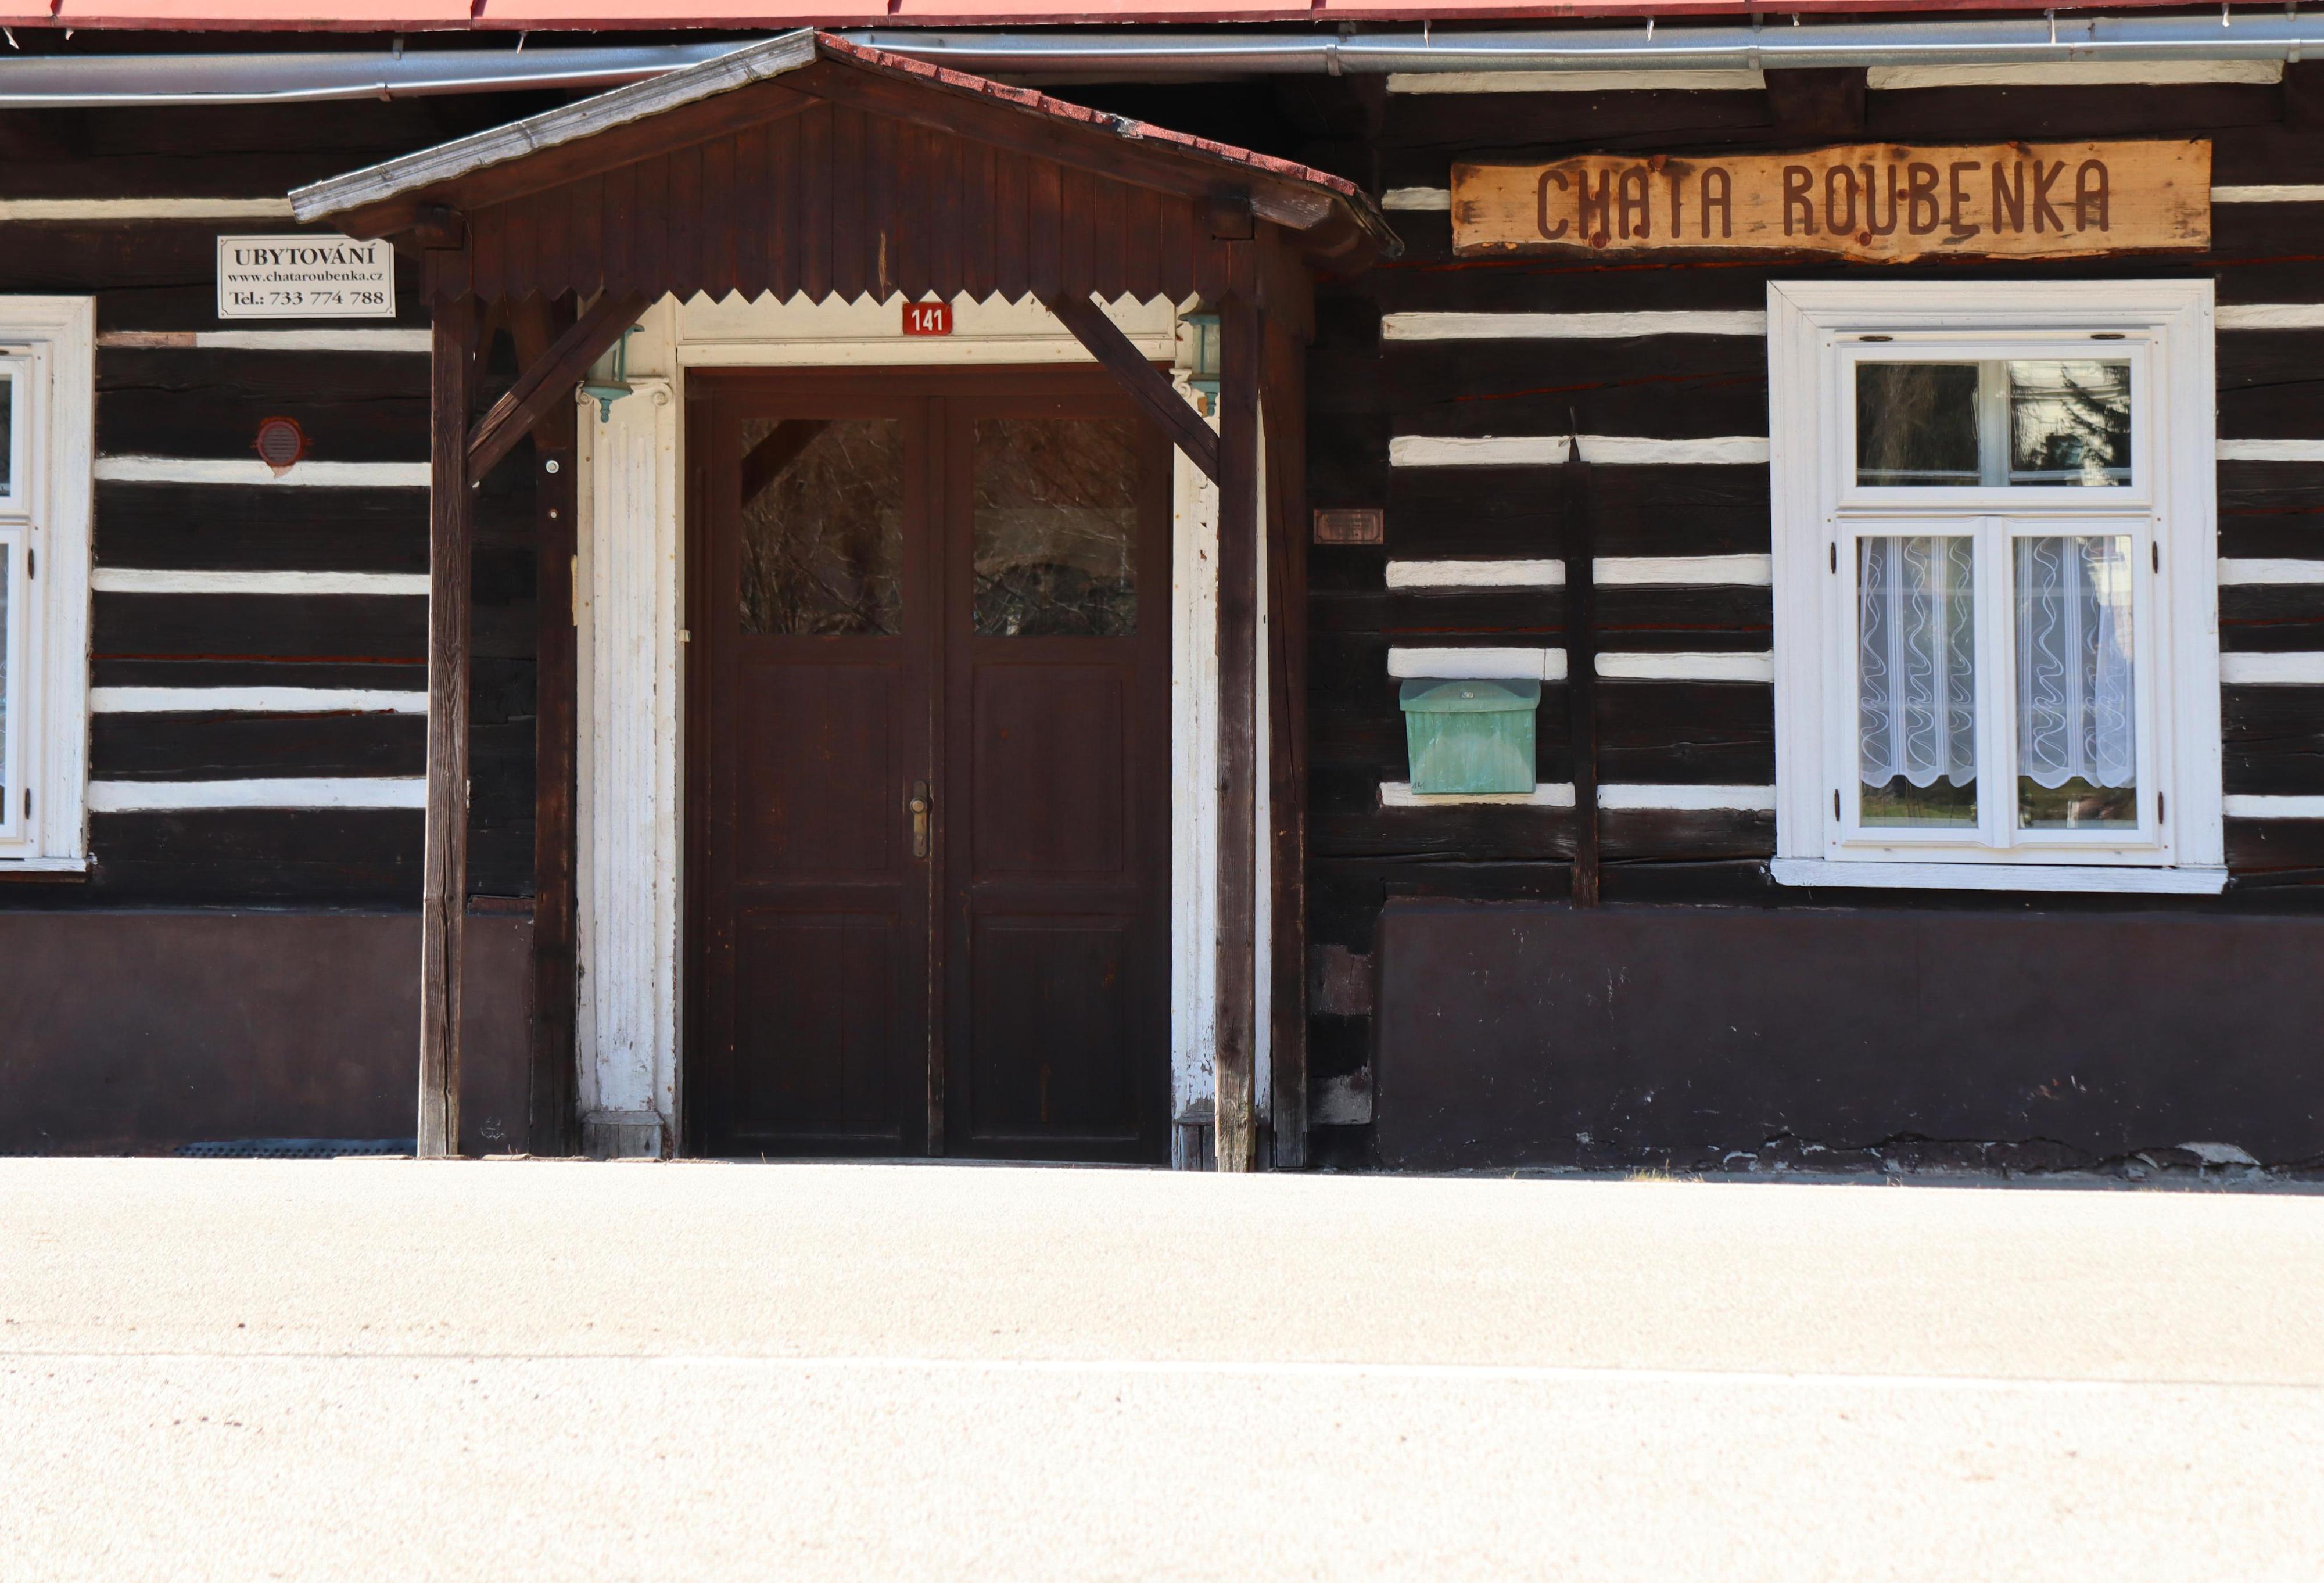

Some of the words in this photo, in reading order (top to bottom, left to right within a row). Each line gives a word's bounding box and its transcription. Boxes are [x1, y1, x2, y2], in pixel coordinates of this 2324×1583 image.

[1538, 165, 1731, 240] CHATA
[1783, 159, 2109, 236] ROUBENKA
[234, 243, 376, 266] UBYTOVÁNÍ
[228, 271, 383, 282] www.chataroubenka.cz
[229, 292, 264, 305] Tel.:
[270, 292, 303, 306] 733
[310, 291, 343, 305] 774
[350, 292, 384, 305] 788
[912, 309, 942, 331] 141
